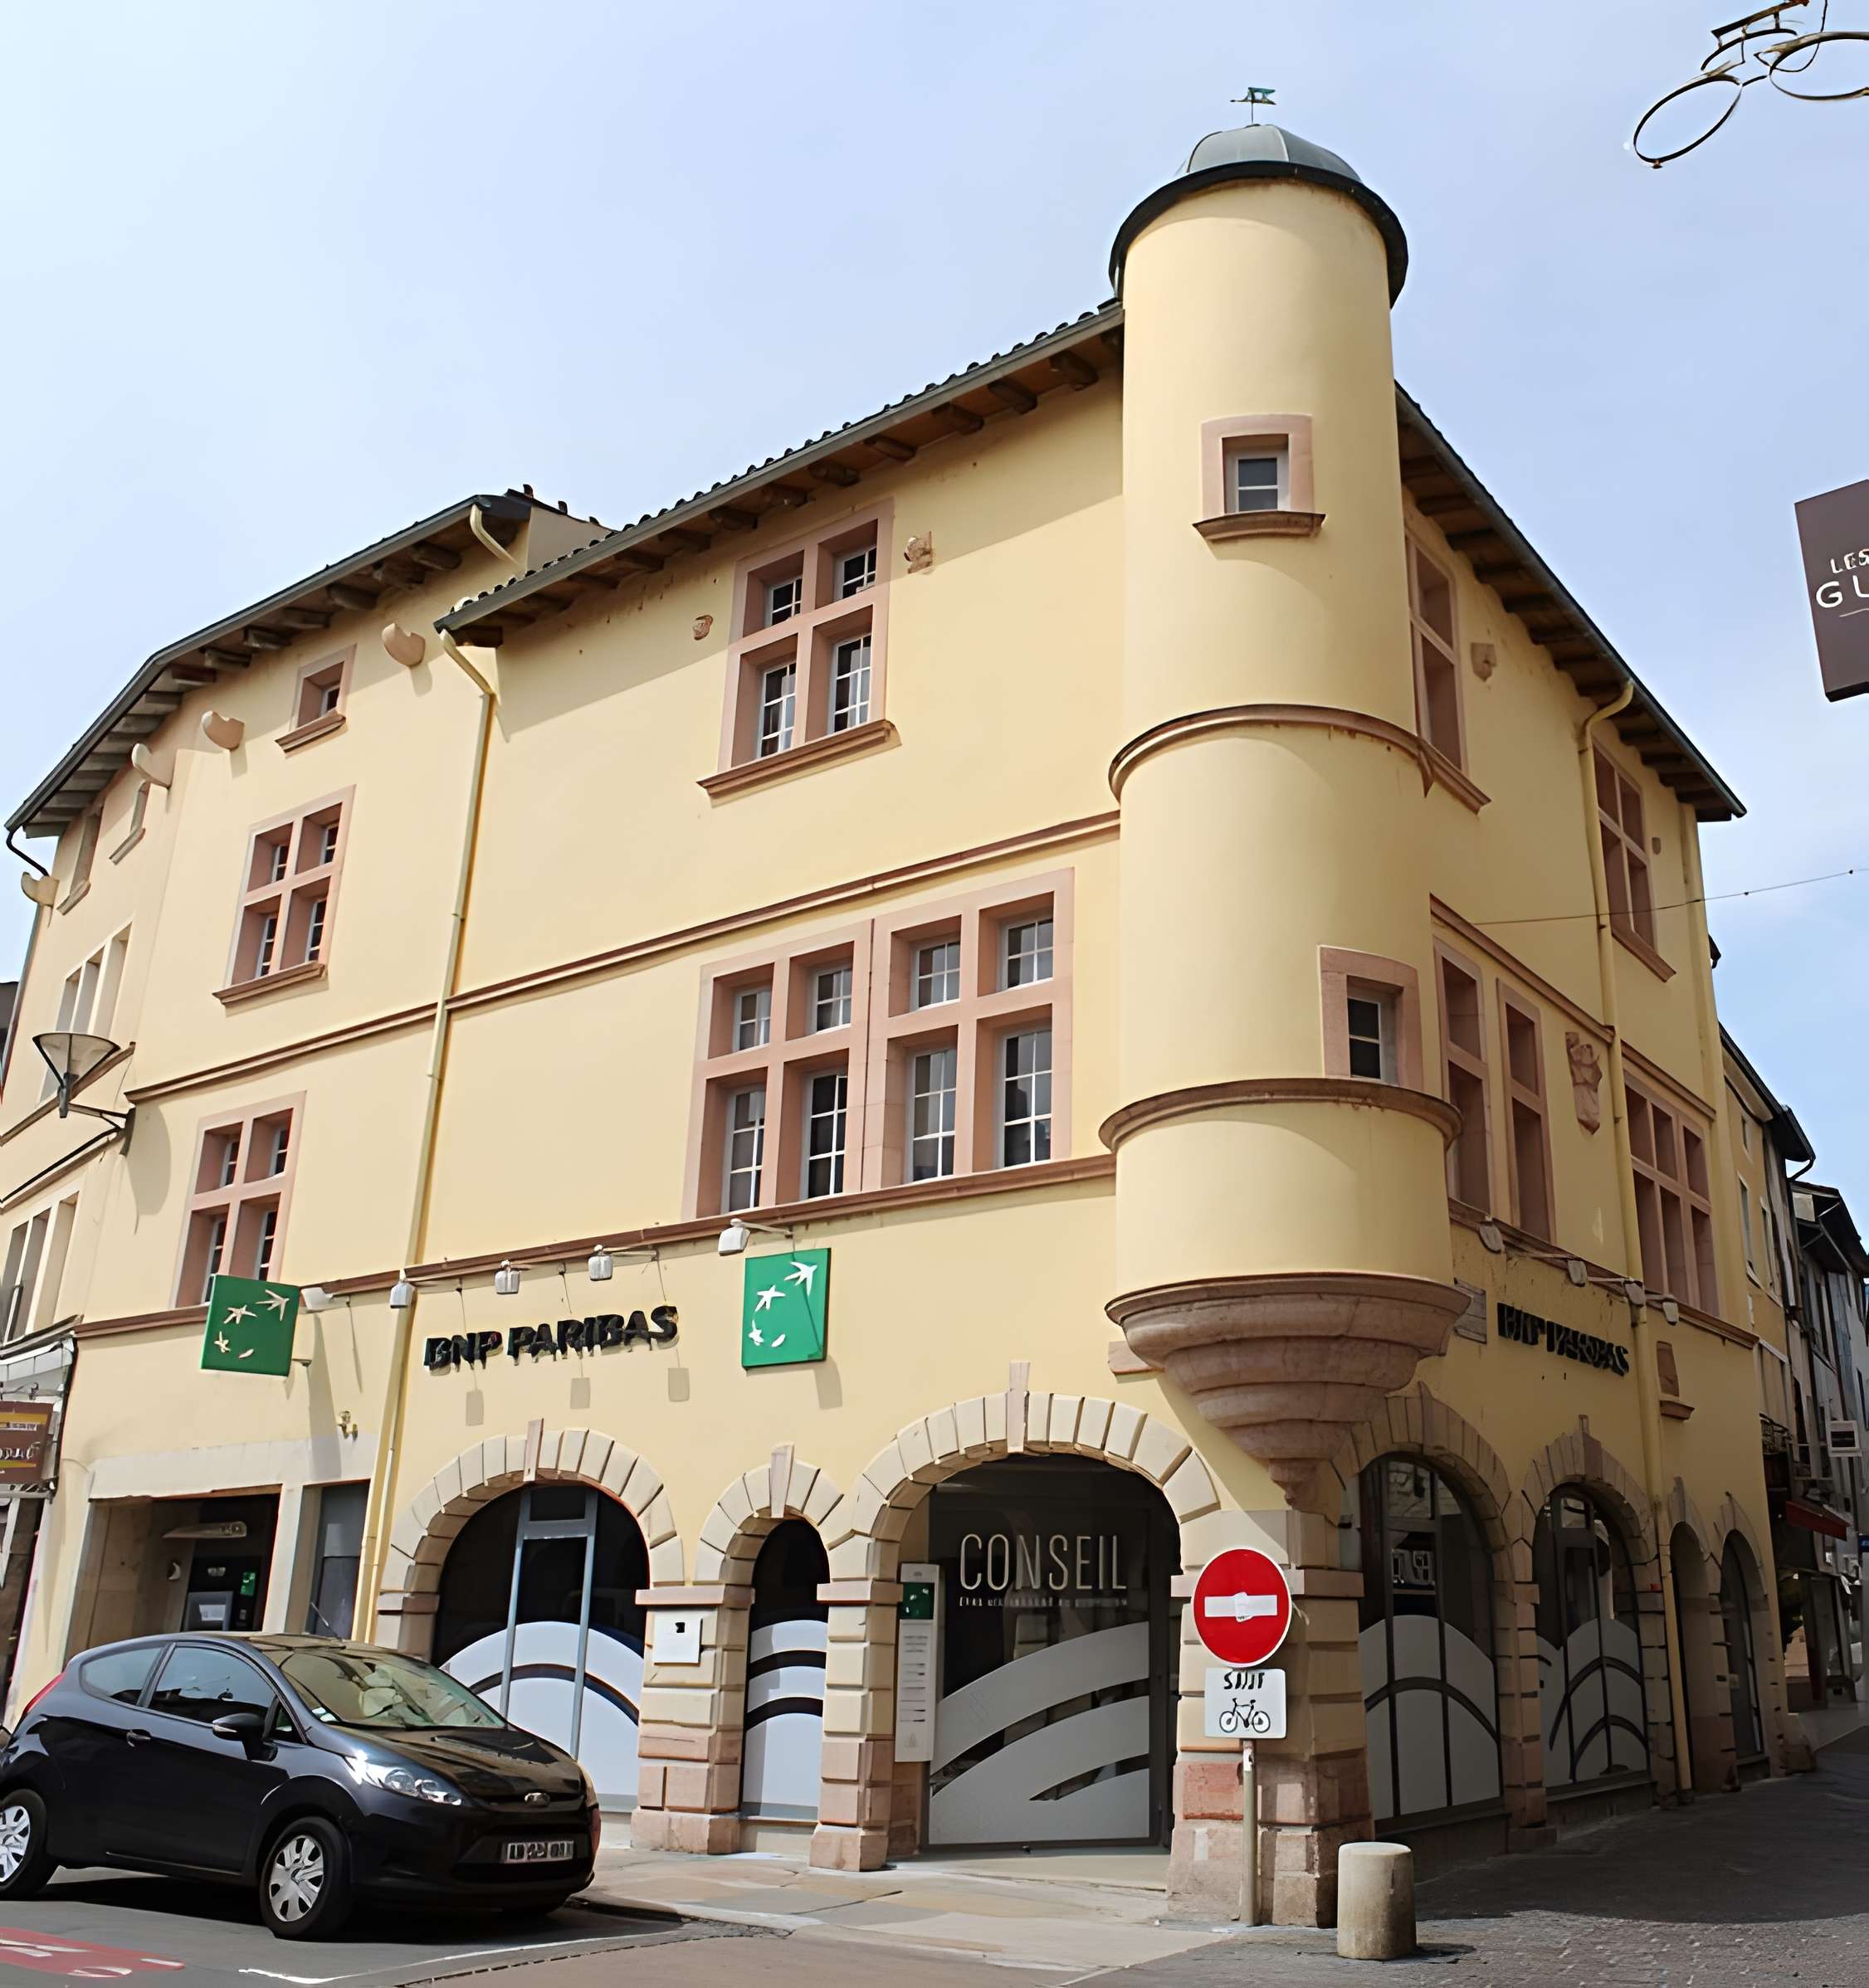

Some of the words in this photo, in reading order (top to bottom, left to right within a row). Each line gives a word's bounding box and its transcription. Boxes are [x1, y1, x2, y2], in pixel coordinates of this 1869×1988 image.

[424, 1330, 504, 1373] BNP
[507, 1305, 680, 1365] PARIBAS
[959, 1533, 1127, 1591] CONSEIL
